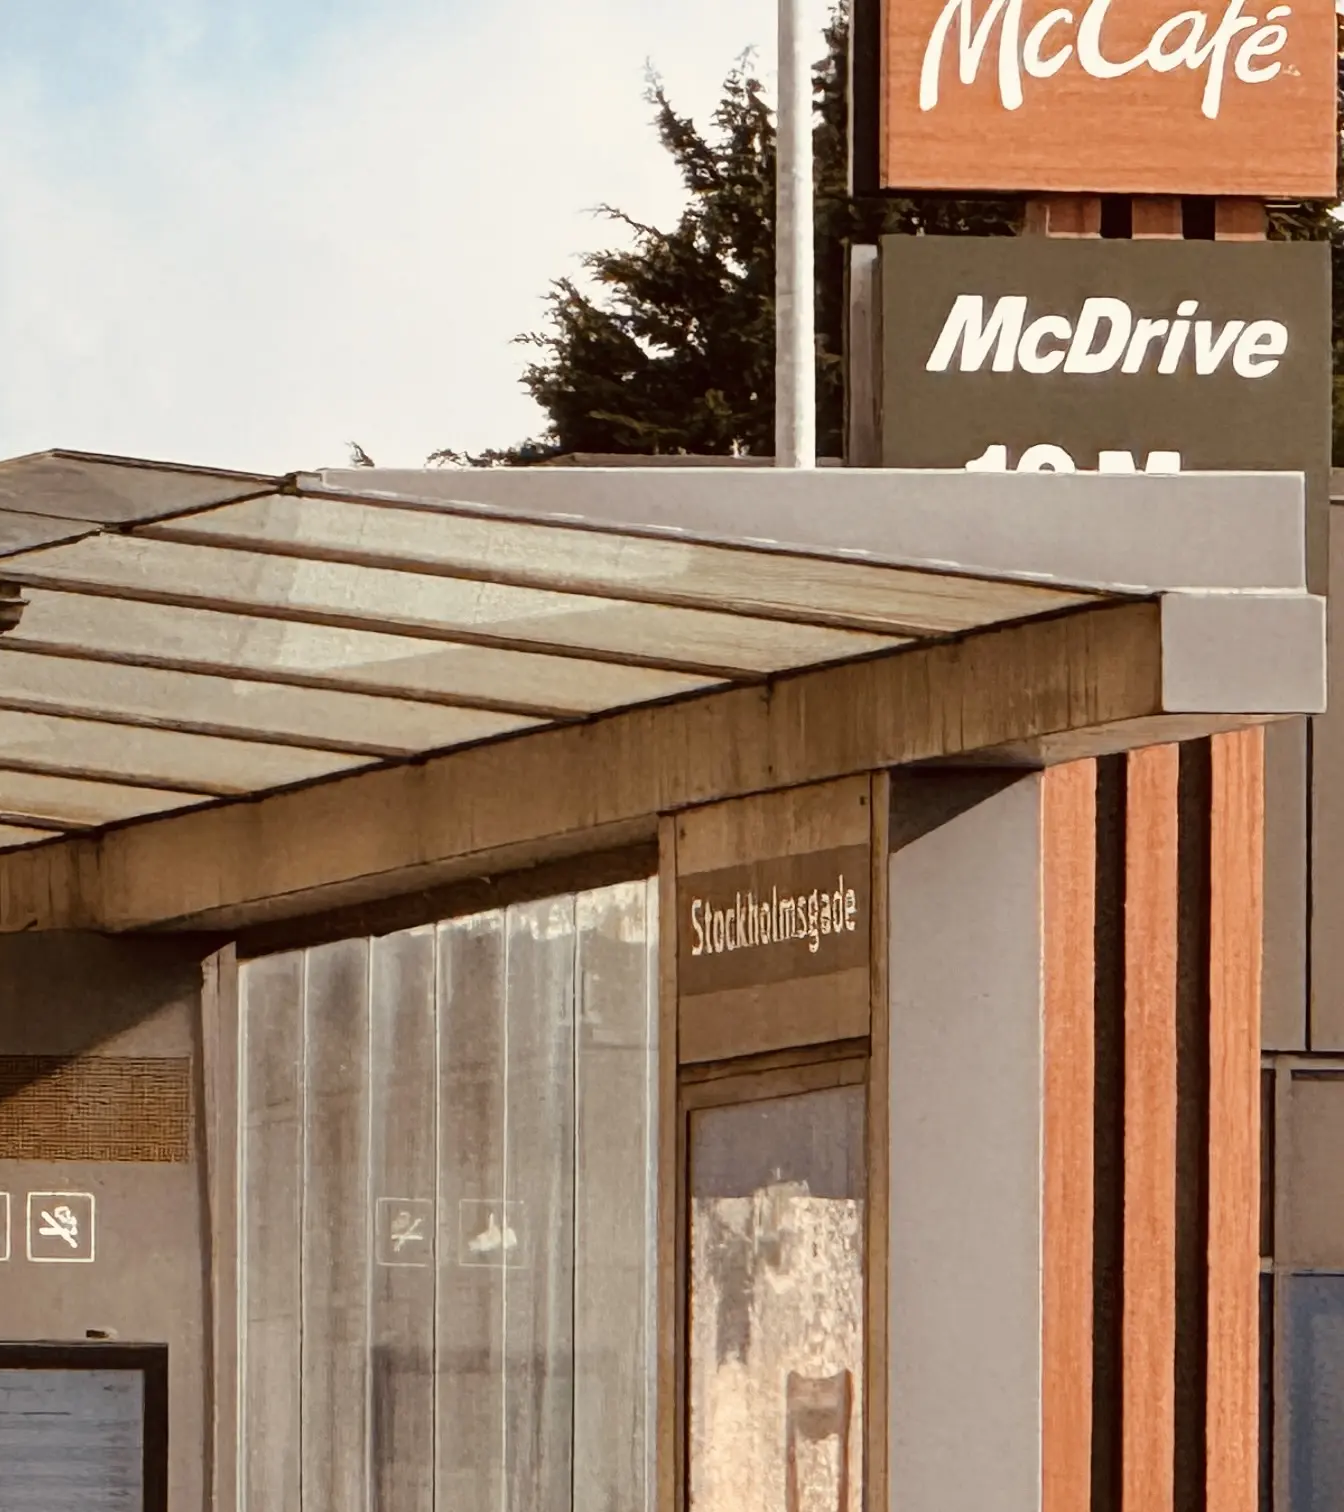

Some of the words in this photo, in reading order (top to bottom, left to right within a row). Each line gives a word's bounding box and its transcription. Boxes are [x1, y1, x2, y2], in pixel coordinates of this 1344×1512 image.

[919, 0, 1292, 119] McCafé
[925, 294, 1289, 379] McDrive
[691, 873, 857, 956] Stockholmsgade
